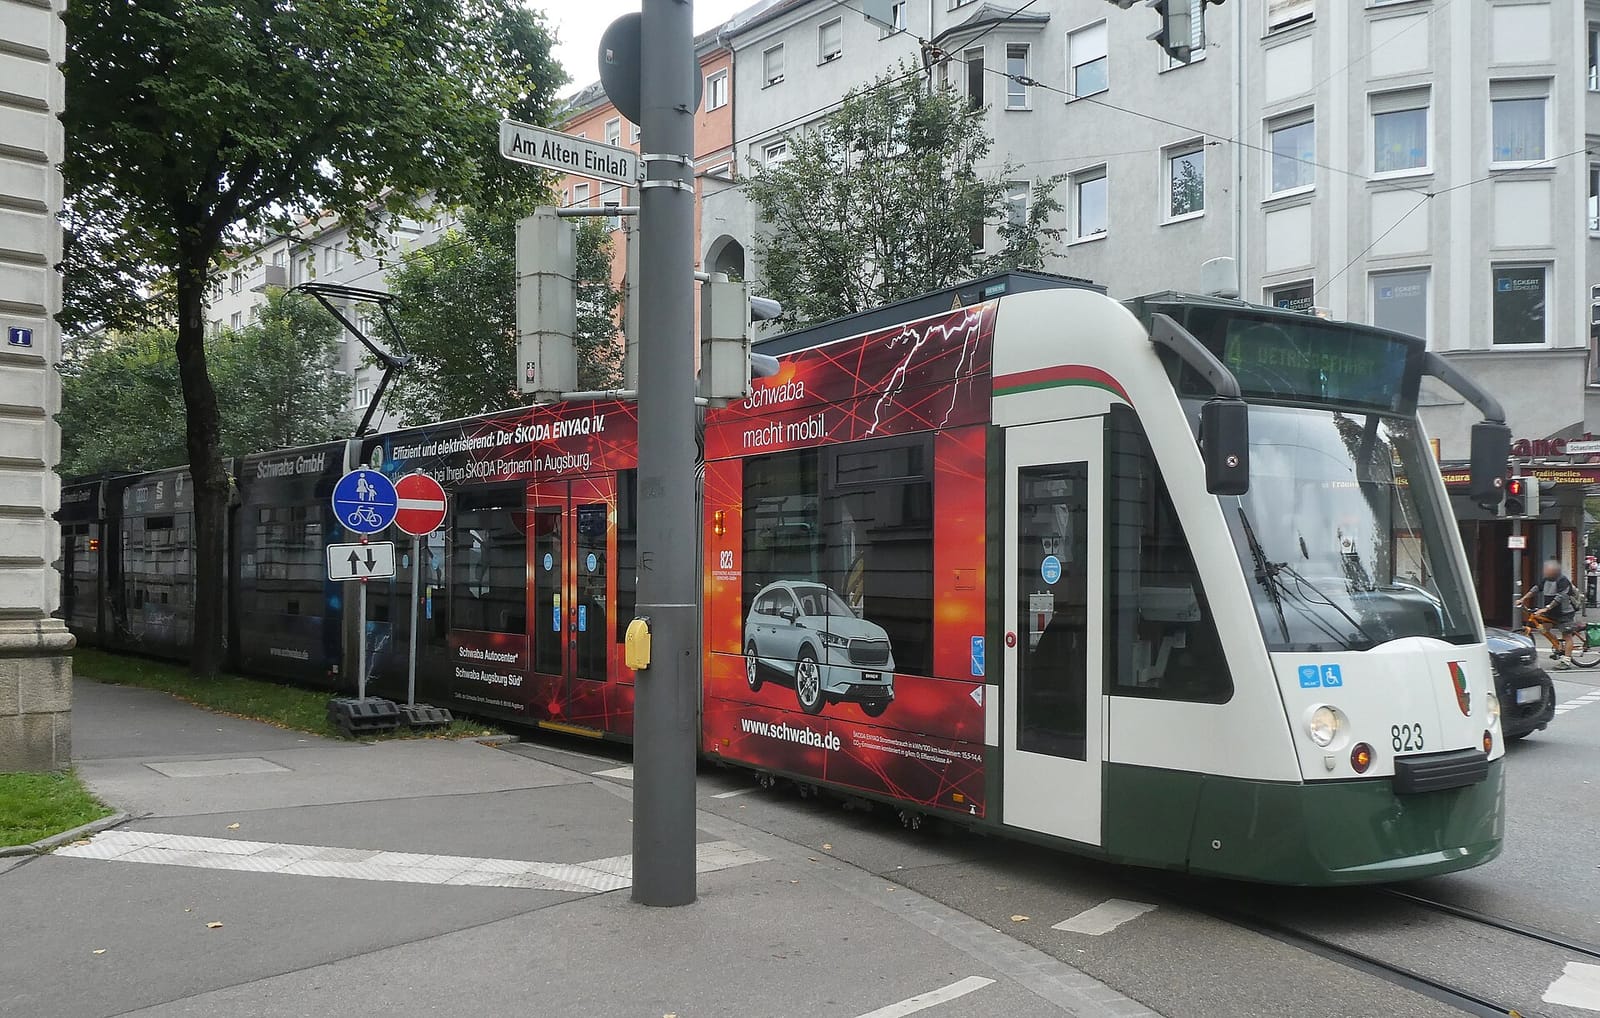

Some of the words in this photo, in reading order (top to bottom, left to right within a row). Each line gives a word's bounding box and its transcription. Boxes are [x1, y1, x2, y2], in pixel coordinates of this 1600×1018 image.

[513, 133, 536, 156] Am
[542, 140, 579, 166] Alten
[584, 150, 627, 177] Einlaß
[16, 330, 24, 344] 1
[743, 378, 804, 409] Schwaba
[392, 442, 422, 461] Effizient
[422, 441, 437, 457] und
[438, 433, 495, 456] elektrisierend:
[496, 430, 512, 446] Der
[515, 424, 550, 444] ŠKODA
[552, 417, 589, 439] ENYAQ
[592, 414, 605, 433] iV.
[743, 421, 783, 448] macht
[787, 413, 828, 441] mobil.
[256, 457, 294, 479] Schwaba
[295, 452, 326, 475] GmbH
[434, 467, 446, 482] bei
[446, 465, 464, 482] Ihren
[466, 458, 495, 480] ŠKODA
[497, 456, 533, 475] Partnern
[534, 455, 543, 471] in
[544, 452, 592, 476] Augsburg.
[1442, 474, 1471, 482] staura
[720, 550, 733, 569] 823
[459, 646, 484, 660] Schwaba
[455, 667, 480, 680] Schwaba
[480, 671, 507, 687] Augsburg
[741, 717, 841, 751] www.schwaba.de
[1391, 723, 1424, 752] 823
